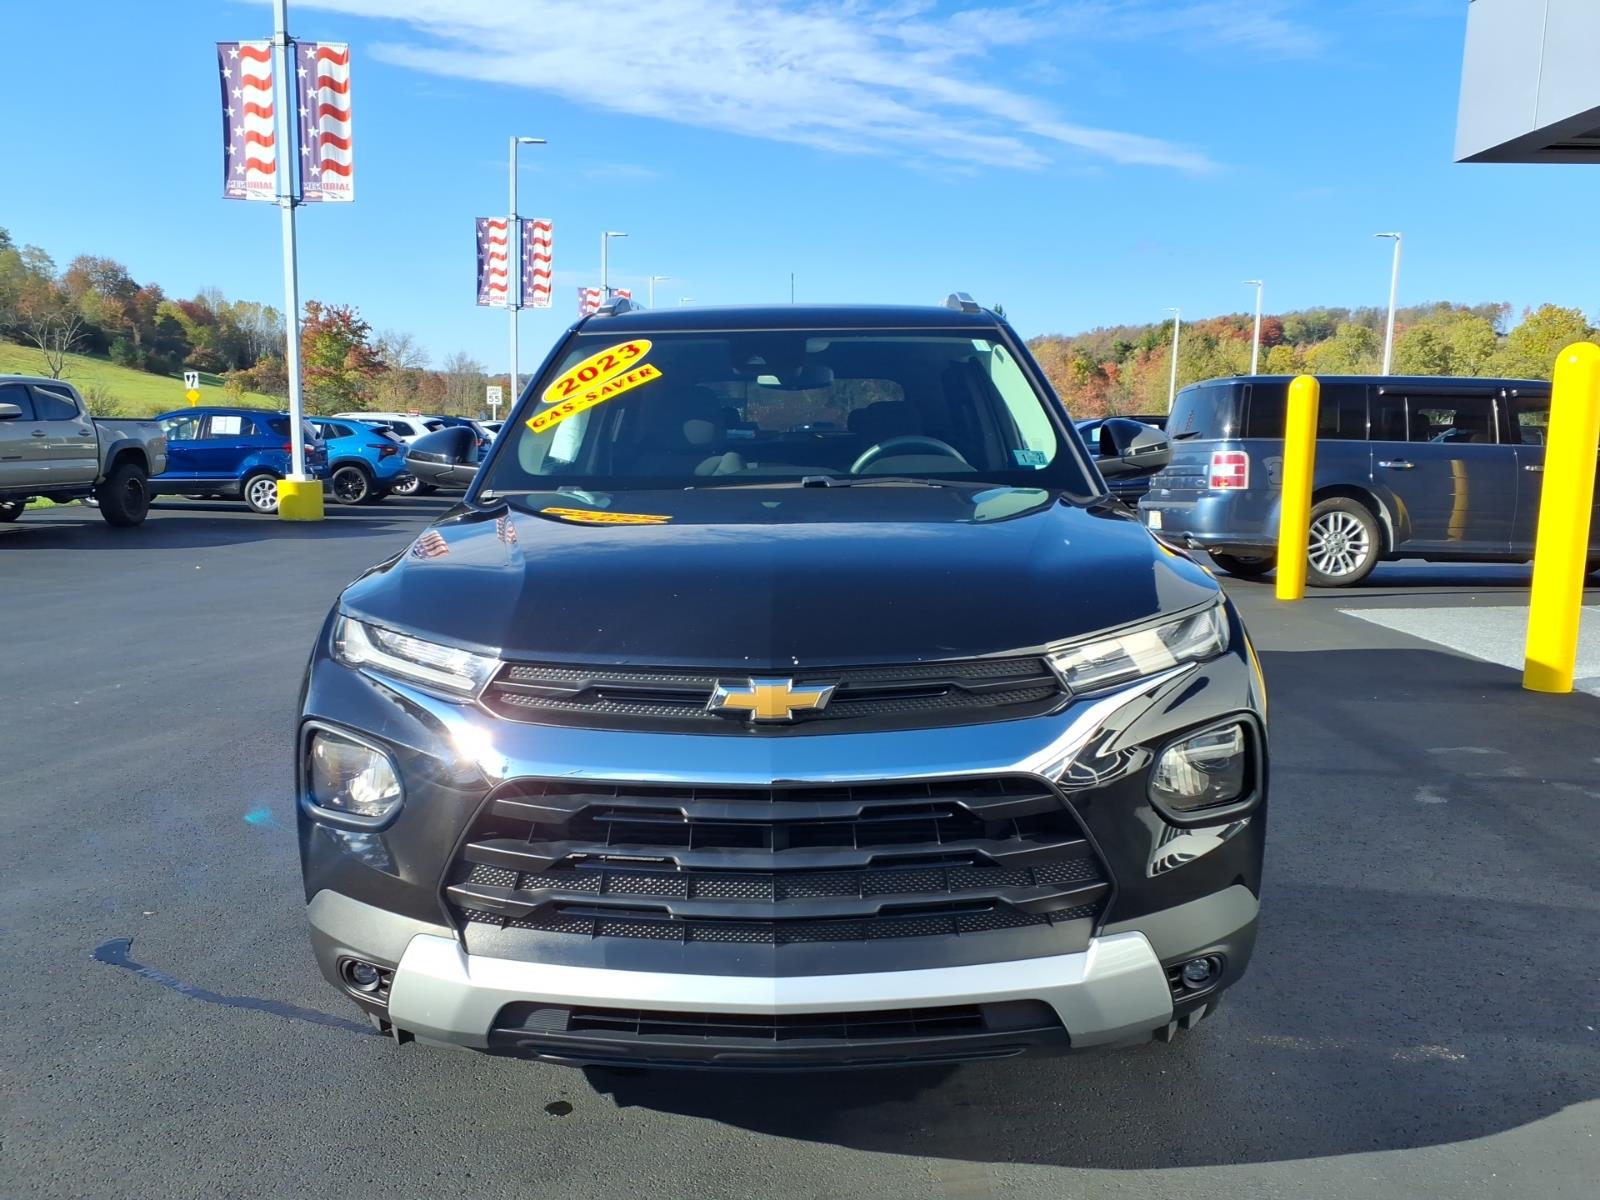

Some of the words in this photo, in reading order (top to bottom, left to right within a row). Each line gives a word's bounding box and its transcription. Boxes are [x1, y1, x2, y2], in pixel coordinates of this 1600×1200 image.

[556, 343, 641, 396] 2023
[488, 395, 501, 403] 55
[532, 367, 653, 429] GAS-SAVER
